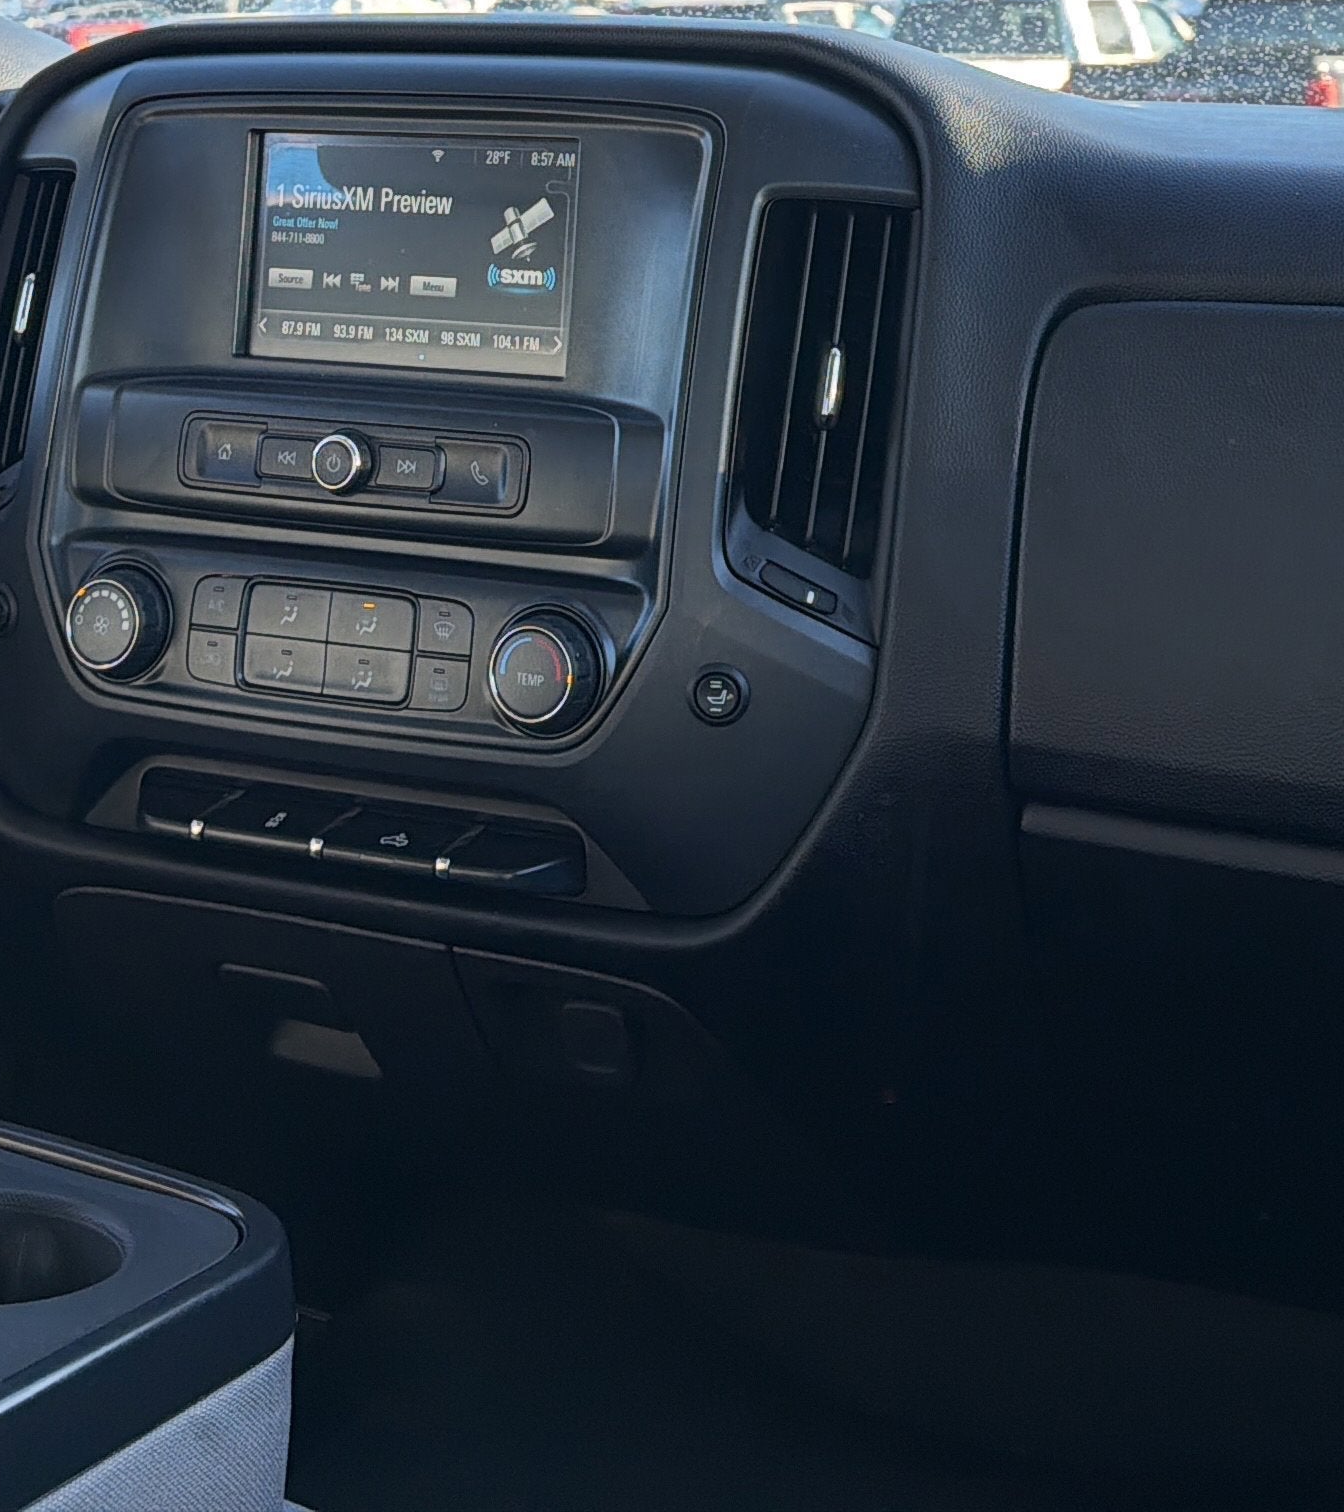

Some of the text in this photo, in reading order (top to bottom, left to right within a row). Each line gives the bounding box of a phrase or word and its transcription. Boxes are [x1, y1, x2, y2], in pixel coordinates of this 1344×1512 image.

[485, 150, 511, 165] 28°F
[531, 152, 576, 167] 8:57 AM
[292, 184, 374, 212] SiriusXM
[380, 188, 453, 215] Preview
[272, 215, 339, 230] Great Offer Now!
[278, 272, 304, 285] Source
[500, 269, 543, 286] sxm
[422, 281, 444, 292] Menu
[281, 321, 321, 336] 87.9 FM
[333, 324, 374, 340] 93.9 FM
[384, 328, 429, 344] 134 SXM
[440, 331, 481, 347] 98 SXM
[492, 335, 540, 351] 104.1 FM
[517, 672, 545, 687] TEMP
